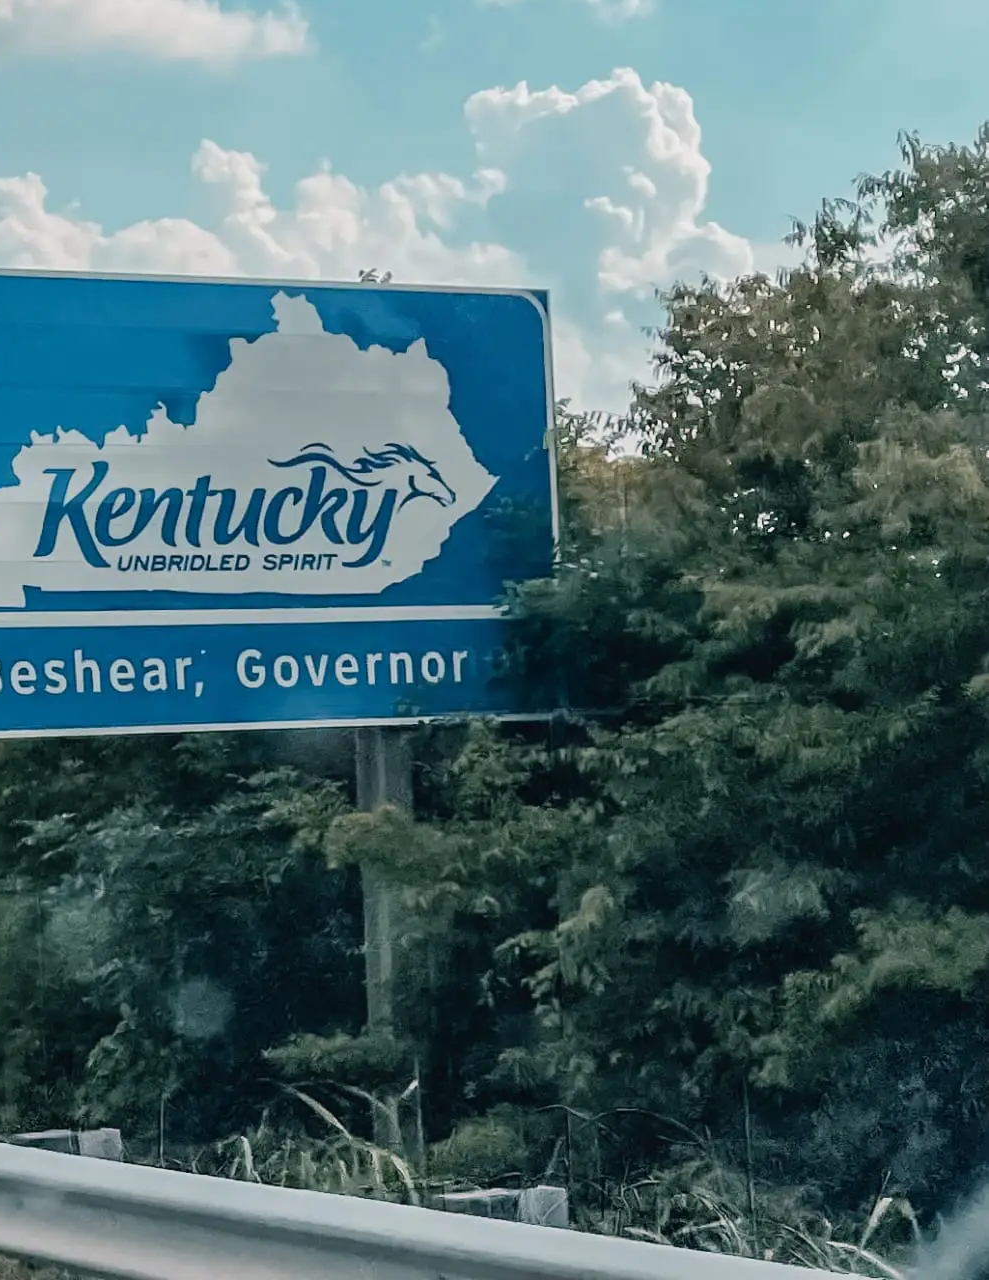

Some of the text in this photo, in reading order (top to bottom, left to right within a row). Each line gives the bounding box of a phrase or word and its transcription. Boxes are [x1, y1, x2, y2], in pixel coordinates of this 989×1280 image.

[32, 460, 397, 568] Kentucky
[117, 553, 339, 572] UNBRIDLED SPIRIT
[236, 648, 468, 689] Governor
